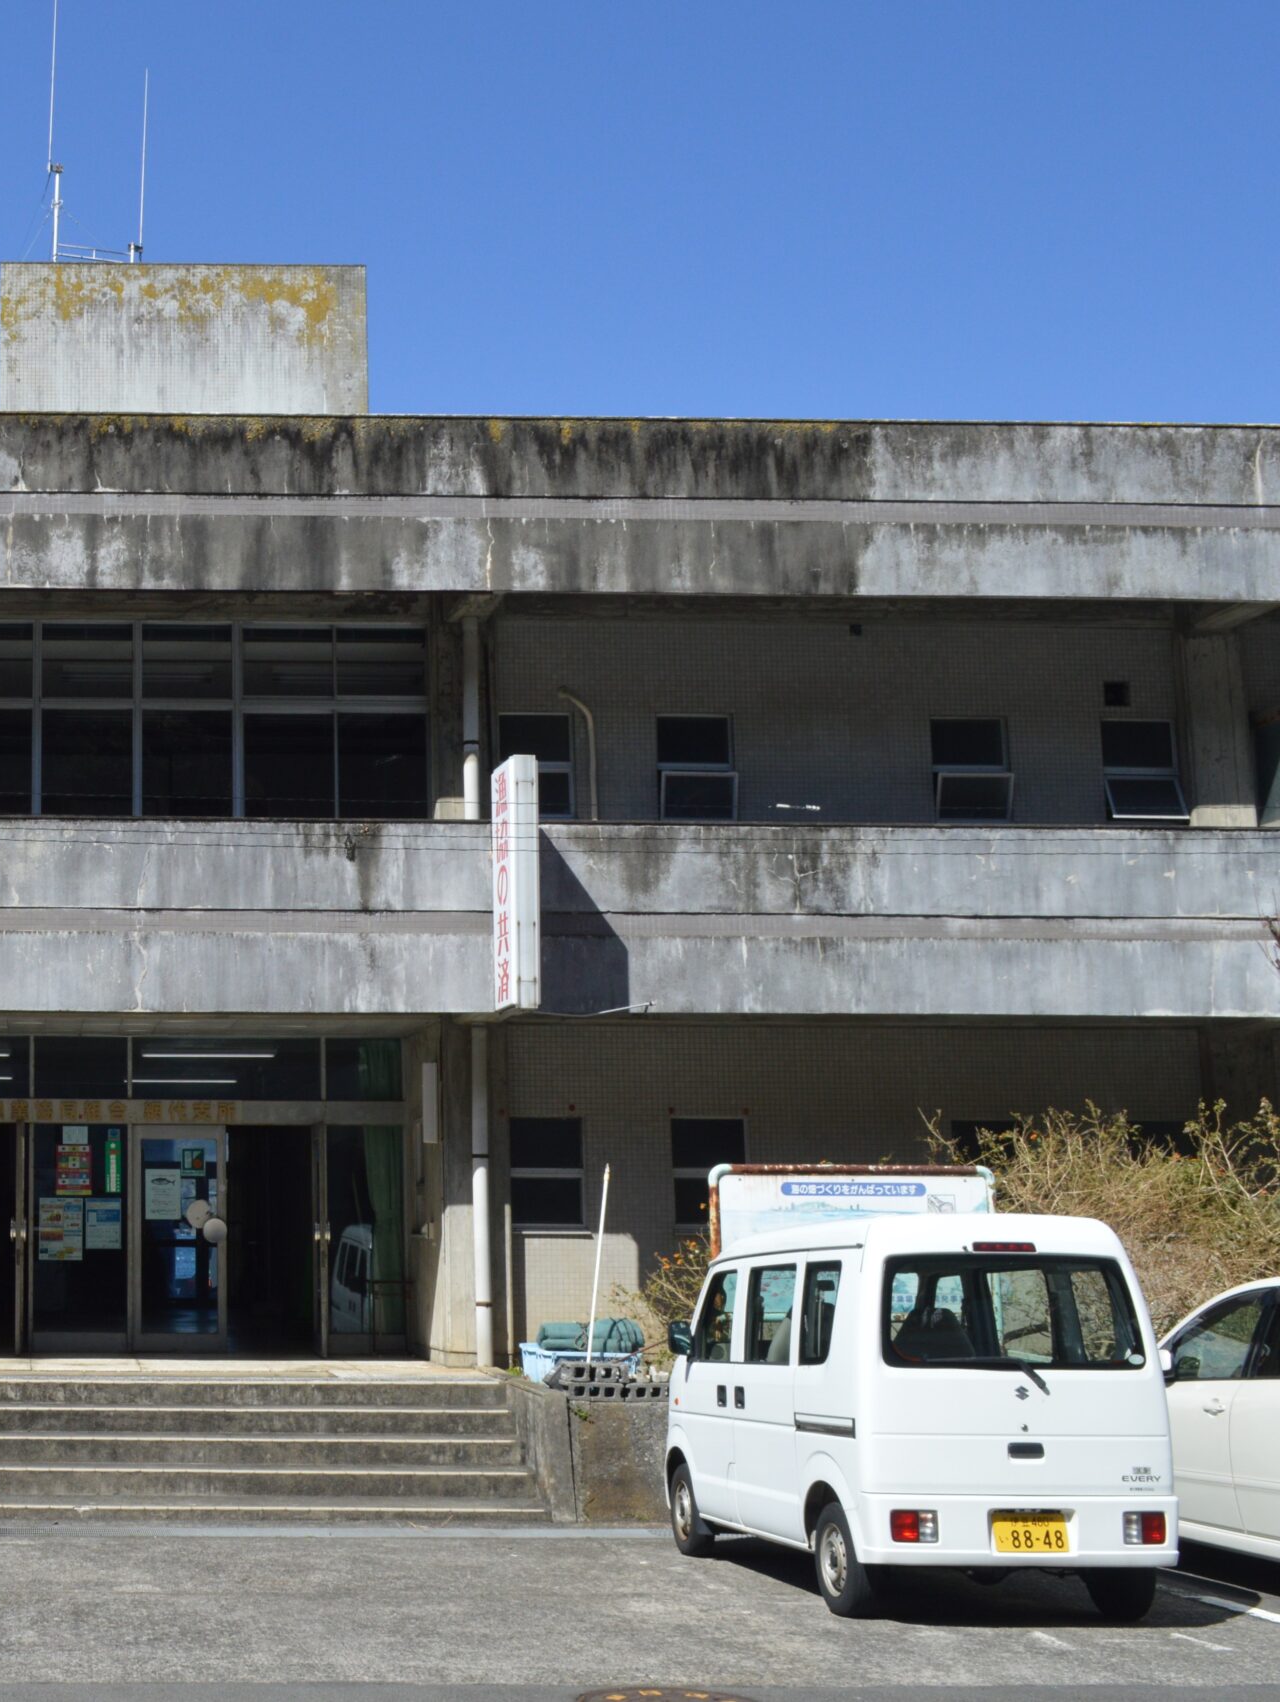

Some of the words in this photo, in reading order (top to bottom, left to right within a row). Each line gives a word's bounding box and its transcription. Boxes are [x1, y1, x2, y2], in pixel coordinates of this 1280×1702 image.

[496, 772, 509, 1002] 漁協の共済
[1011, 1530, 1064, 1548] 88-48
